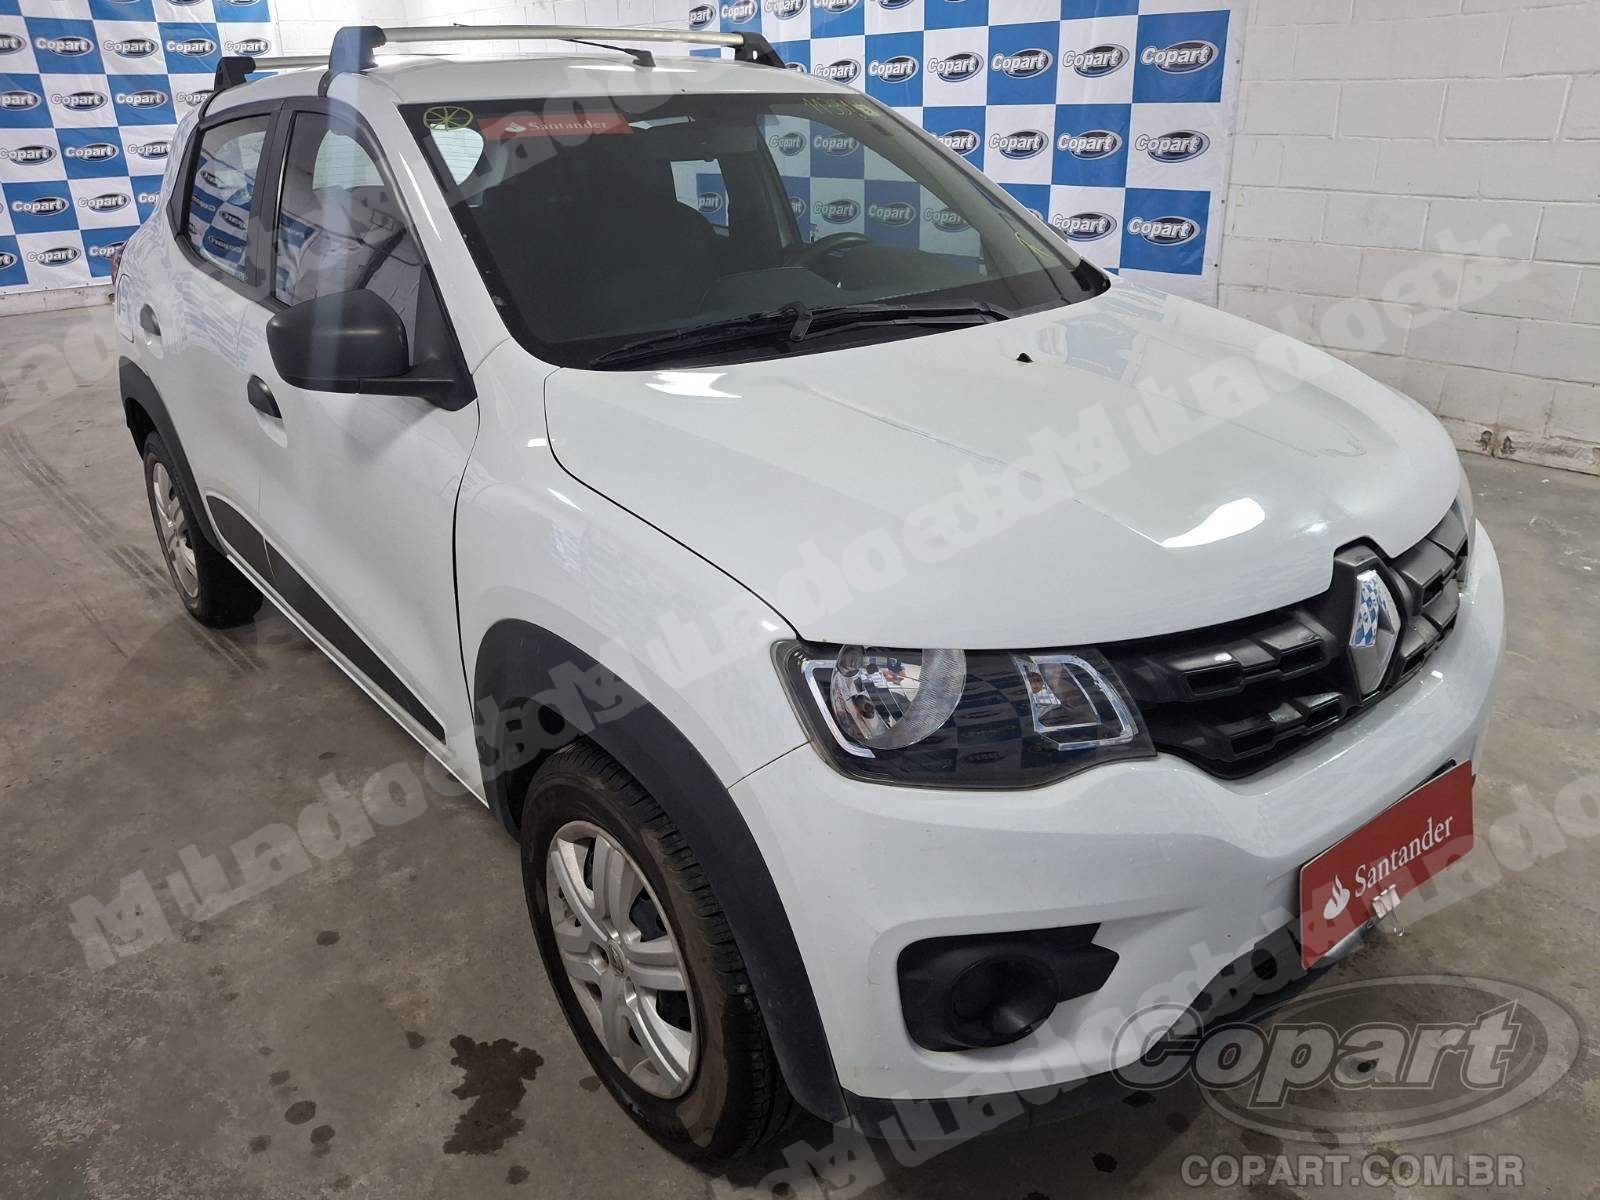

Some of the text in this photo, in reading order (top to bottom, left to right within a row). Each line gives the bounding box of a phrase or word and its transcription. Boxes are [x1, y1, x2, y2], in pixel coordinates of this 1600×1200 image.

[689, 9, 711, 23] part
[721, 3, 754, 20] Copart
[36, 37, 88, 53] Copart
[103, 40, 151, 53] Copart
[166, 40, 212, 53] Copart
[225, 40, 267, 54] Copart
[927, 54, 976, 75] Copart
[991, 50, 1046, 75] Copart
[1063, 48, 1121, 72] Copart
[1140, 45, 1209, 69] Copart
[868, 60, 914, 79] Copart
[0, 94, 35, 107] part
[51, 93, 101, 107] Copart
[115, 93, 161, 107] Copart
[176, 92, 208, 104] Copa
[528, 121, 609, 131] Santander
[814, 135, 855, 152] Copart
[937, 134, 975, 150] part
[989, 133, 1040, 153] Copart
[1057, 132, 1114, 155] Copart
[1135, 133, 1200, 156] Copart
[0, 147, 50, 161] Copart
[65, 146, 114, 160] Copart
[12, 200, 62, 213] Copart
[78, 195, 124, 210] Copart
[814, 201, 855, 218] Copart
[868, 204, 912, 221] Copart
[1052, 214, 1108, 234] Copart
[1127, 217, 1191, 239] Copart
[26, 250, 76, 263] Copart
[89, 246, 115, 257] Cop
[1355, 816, 1453, 898] Santander
